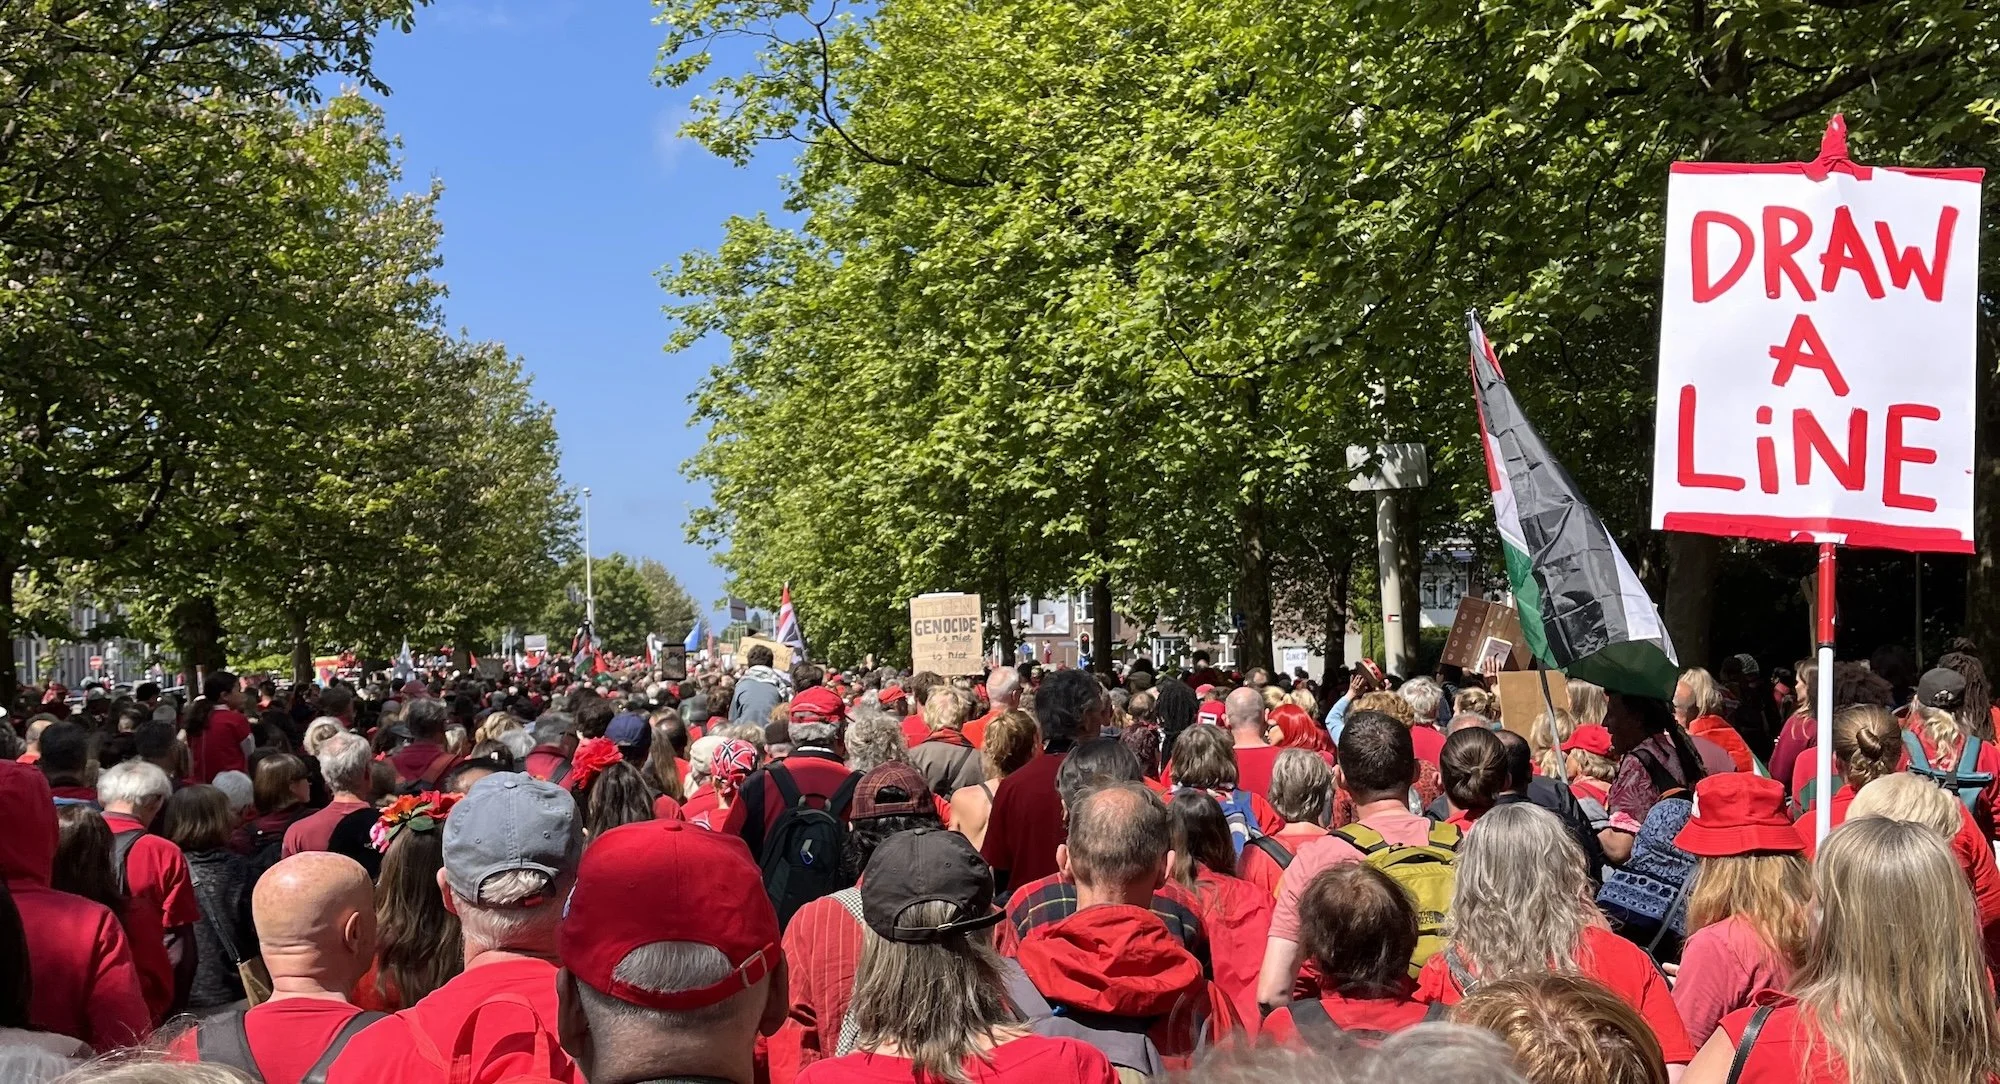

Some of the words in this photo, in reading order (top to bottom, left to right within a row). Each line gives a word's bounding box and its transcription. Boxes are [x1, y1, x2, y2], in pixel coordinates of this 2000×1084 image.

[1690, 205, 1959, 303] DRAW
[1768, 314, 1850, 397] A
[914, 617, 977, 636] GENOCIDE
